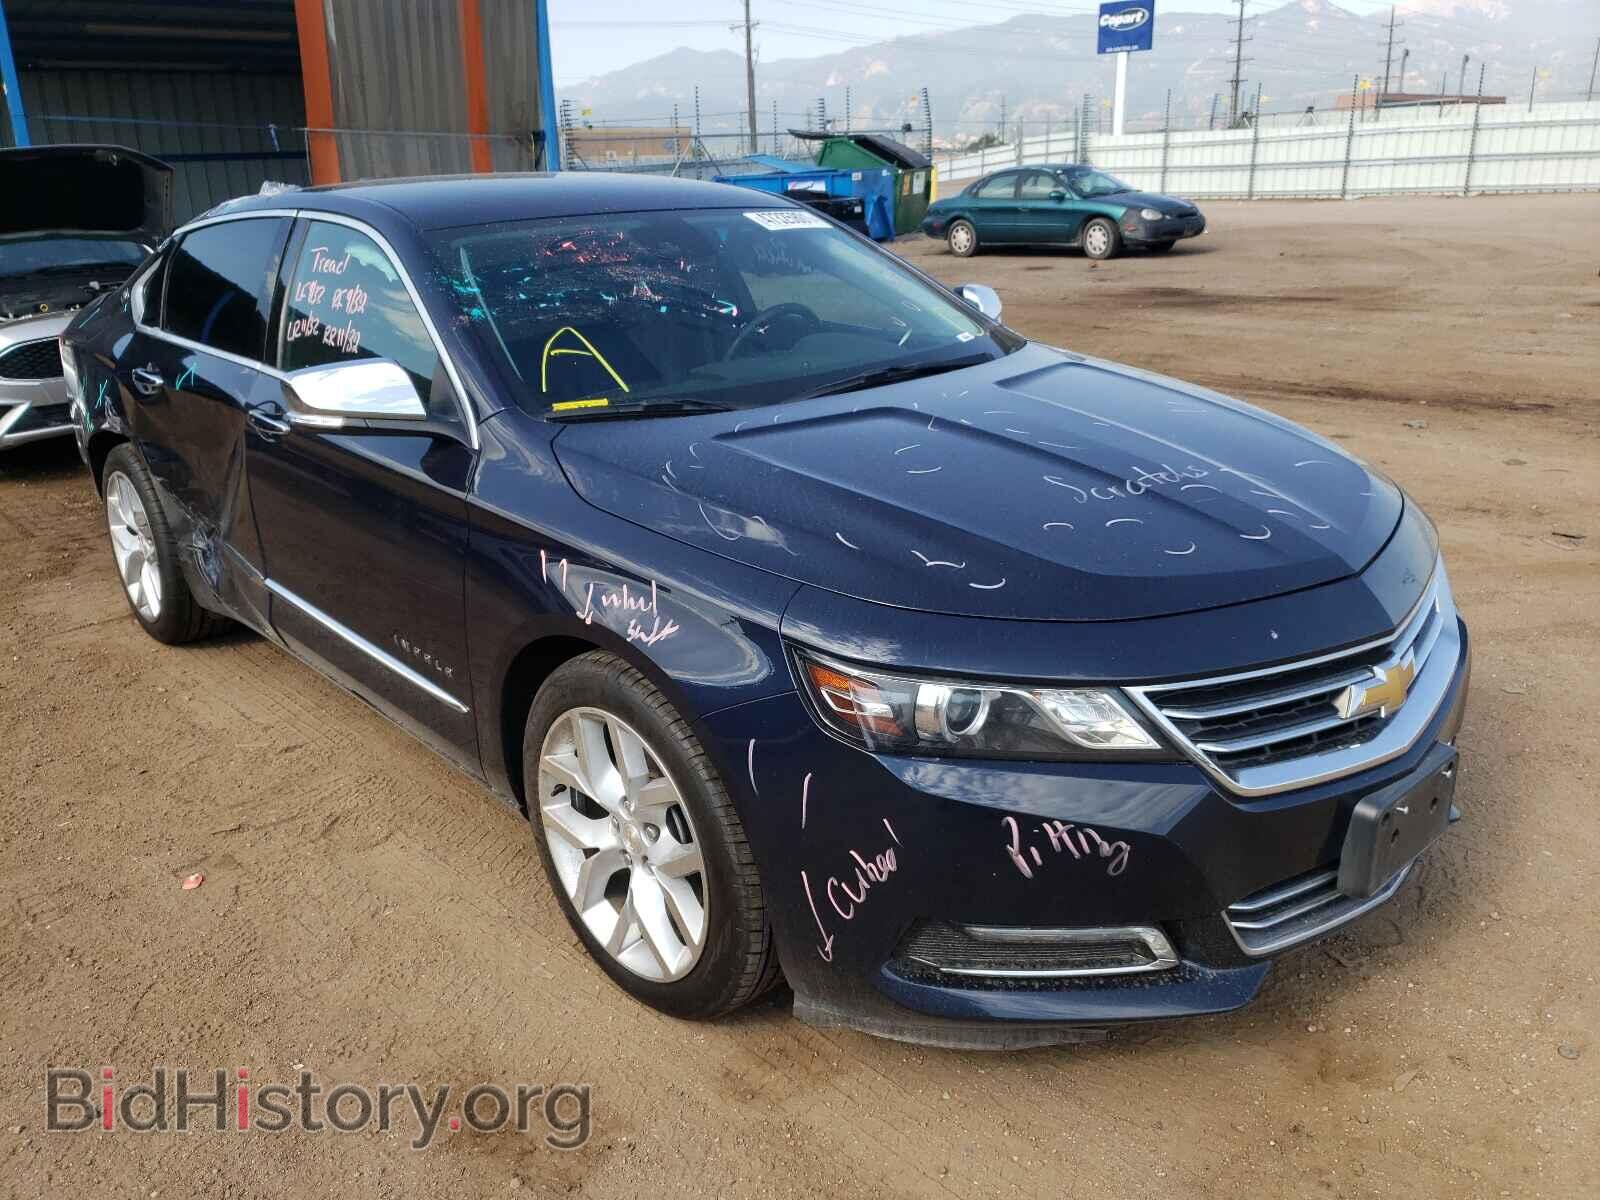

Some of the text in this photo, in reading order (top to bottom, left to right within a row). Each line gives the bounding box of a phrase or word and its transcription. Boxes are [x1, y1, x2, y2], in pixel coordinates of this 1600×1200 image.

[1100, 11, 1143, 28] Copart
[312, 246, 351, 275] Tread
[542, 327, 631, 392] A
